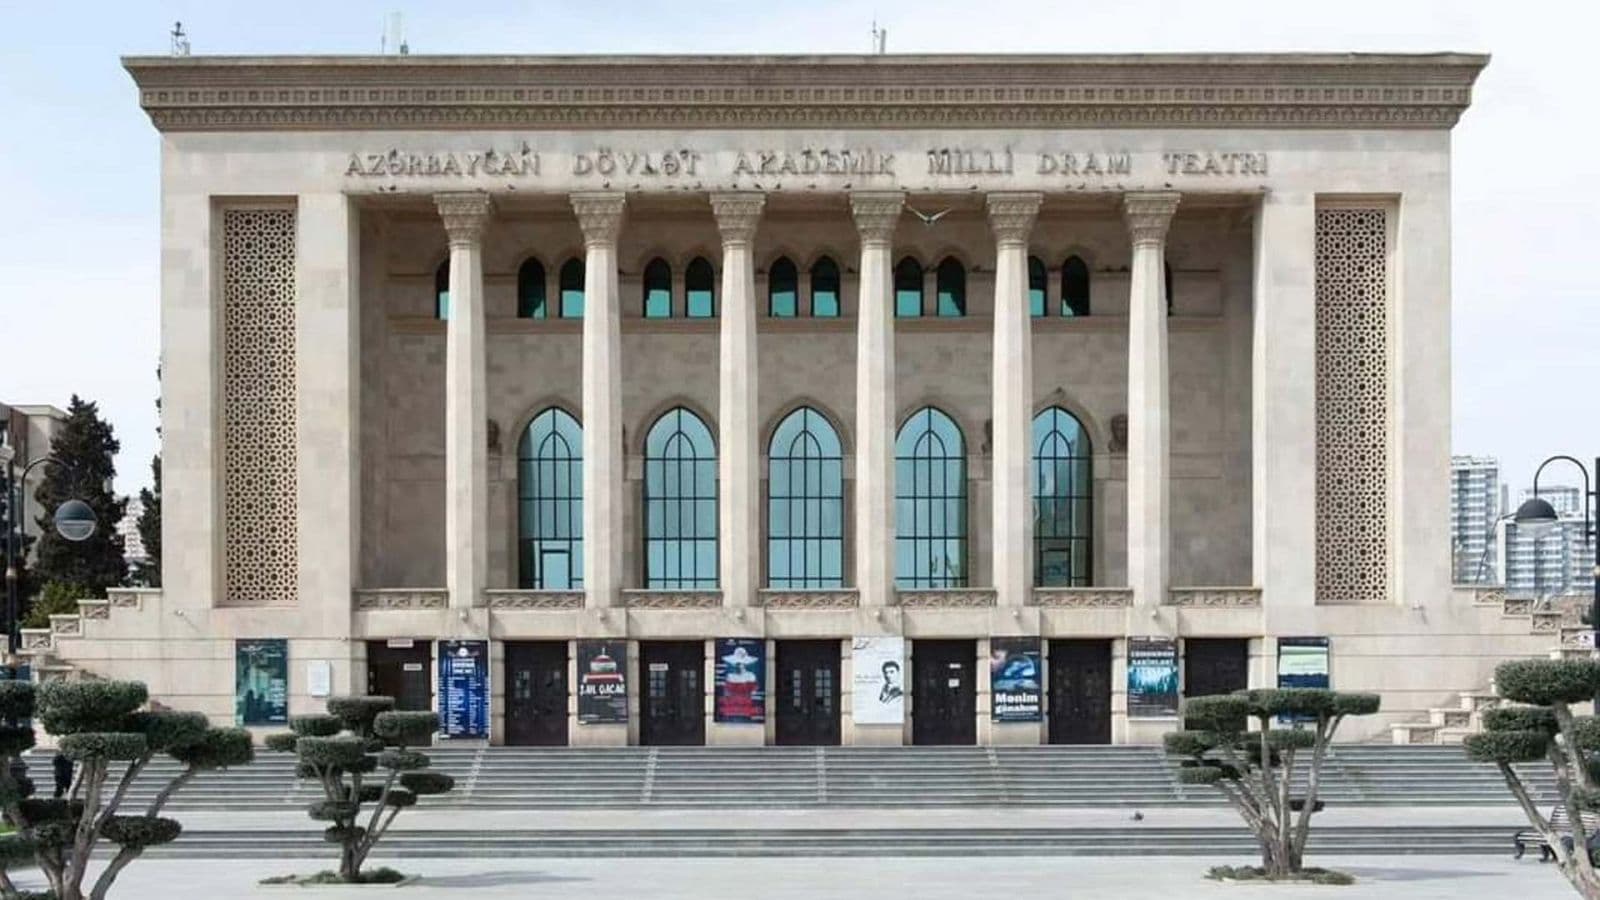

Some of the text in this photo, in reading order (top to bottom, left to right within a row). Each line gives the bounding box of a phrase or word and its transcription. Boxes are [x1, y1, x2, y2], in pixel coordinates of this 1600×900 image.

[345, 152, 540, 176] AZƏRBAYCAN
[573, 148, 703, 175] DÖVLƏT
[733, 150, 896, 176] AKADEMİK
[927, 148, 1013, 174] MİLLİ
[1036, 153, 1132, 174] DRAM
